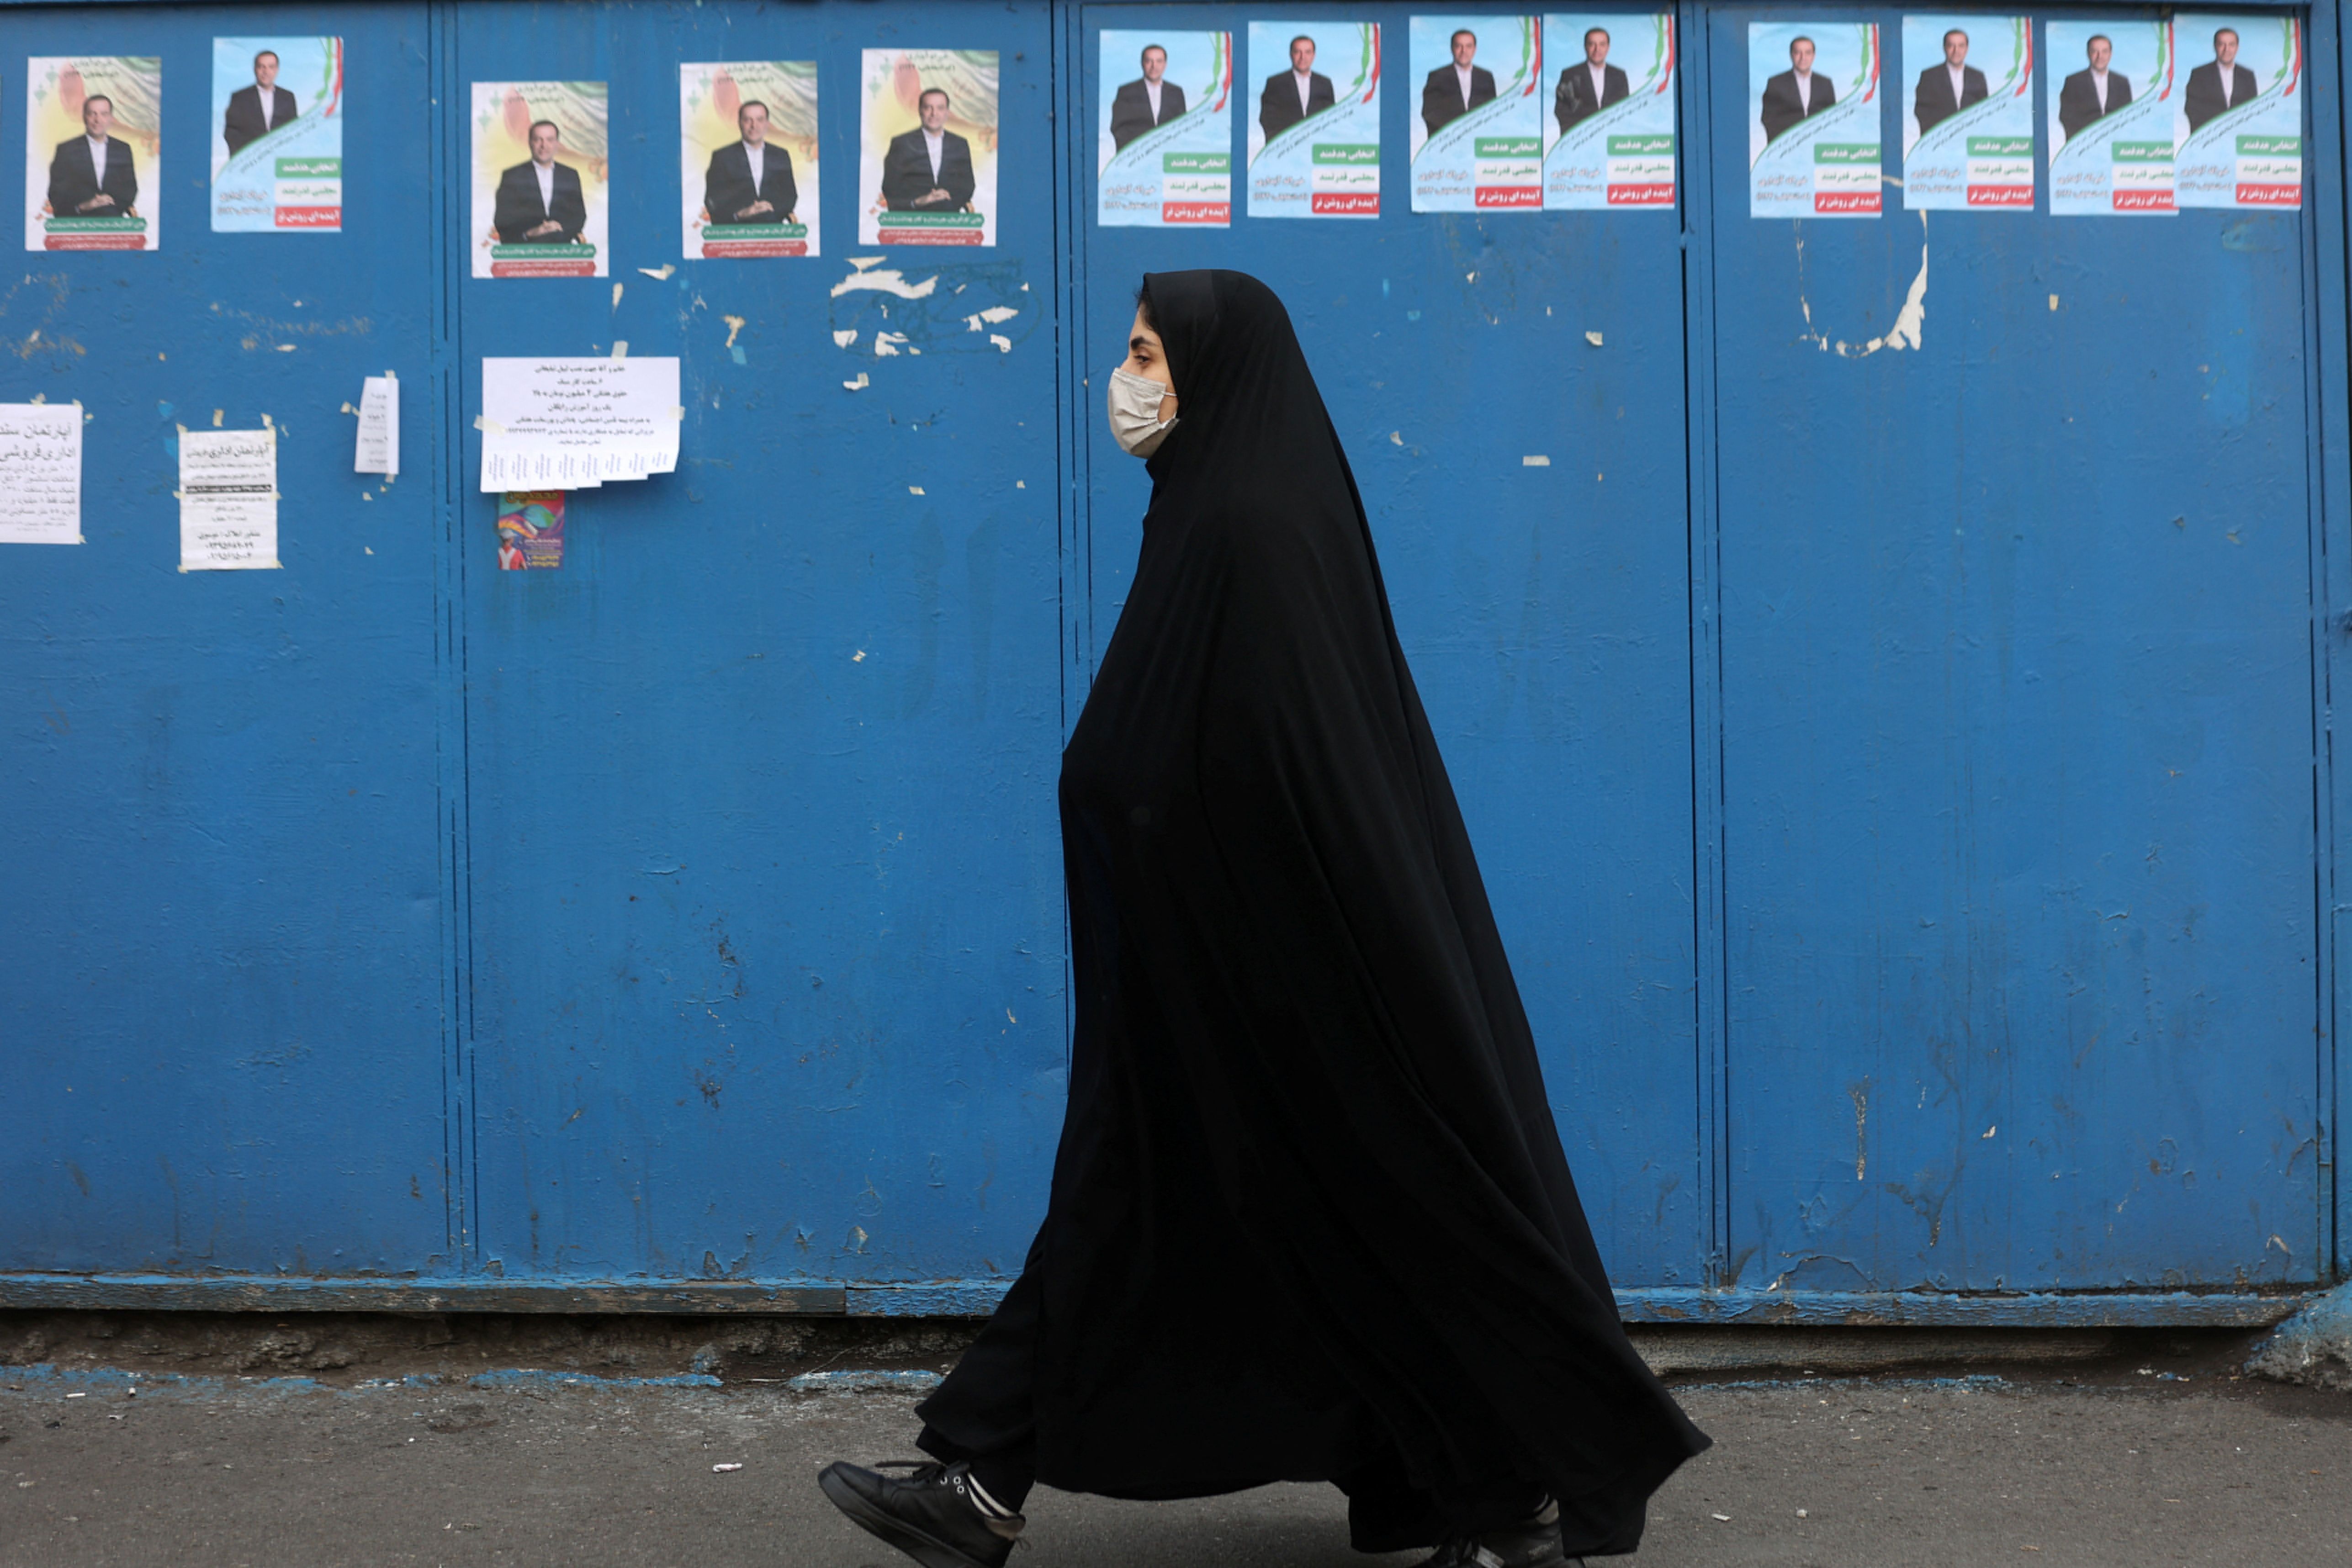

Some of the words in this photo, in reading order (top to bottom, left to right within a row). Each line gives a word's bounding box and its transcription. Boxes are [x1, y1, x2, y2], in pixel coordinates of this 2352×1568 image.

[1510, 142, 1538, 154] انتخابی
[1643, 140, 1670, 151] انتخابی
[2002, 142, 2029, 153] انتخابی
[2271, 141, 2298, 152] انتخابی
[1348, 149, 1376, 161] انتخابی
[1849, 148, 1877, 159] انتخابی
[1199, 158, 1227, 170] انتخابی
[1521, 190, 1541, 202] آینده
[1653, 187, 1673, 199] آینده
[2013, 188, 2032, 201] آینده
[2281, 188, 2300, 200] آینده
[1358, 196, 1378, 209] آینده
[1860, 196, 1880, 207] آینده
[1209, 206, 1229, 218] آینده
